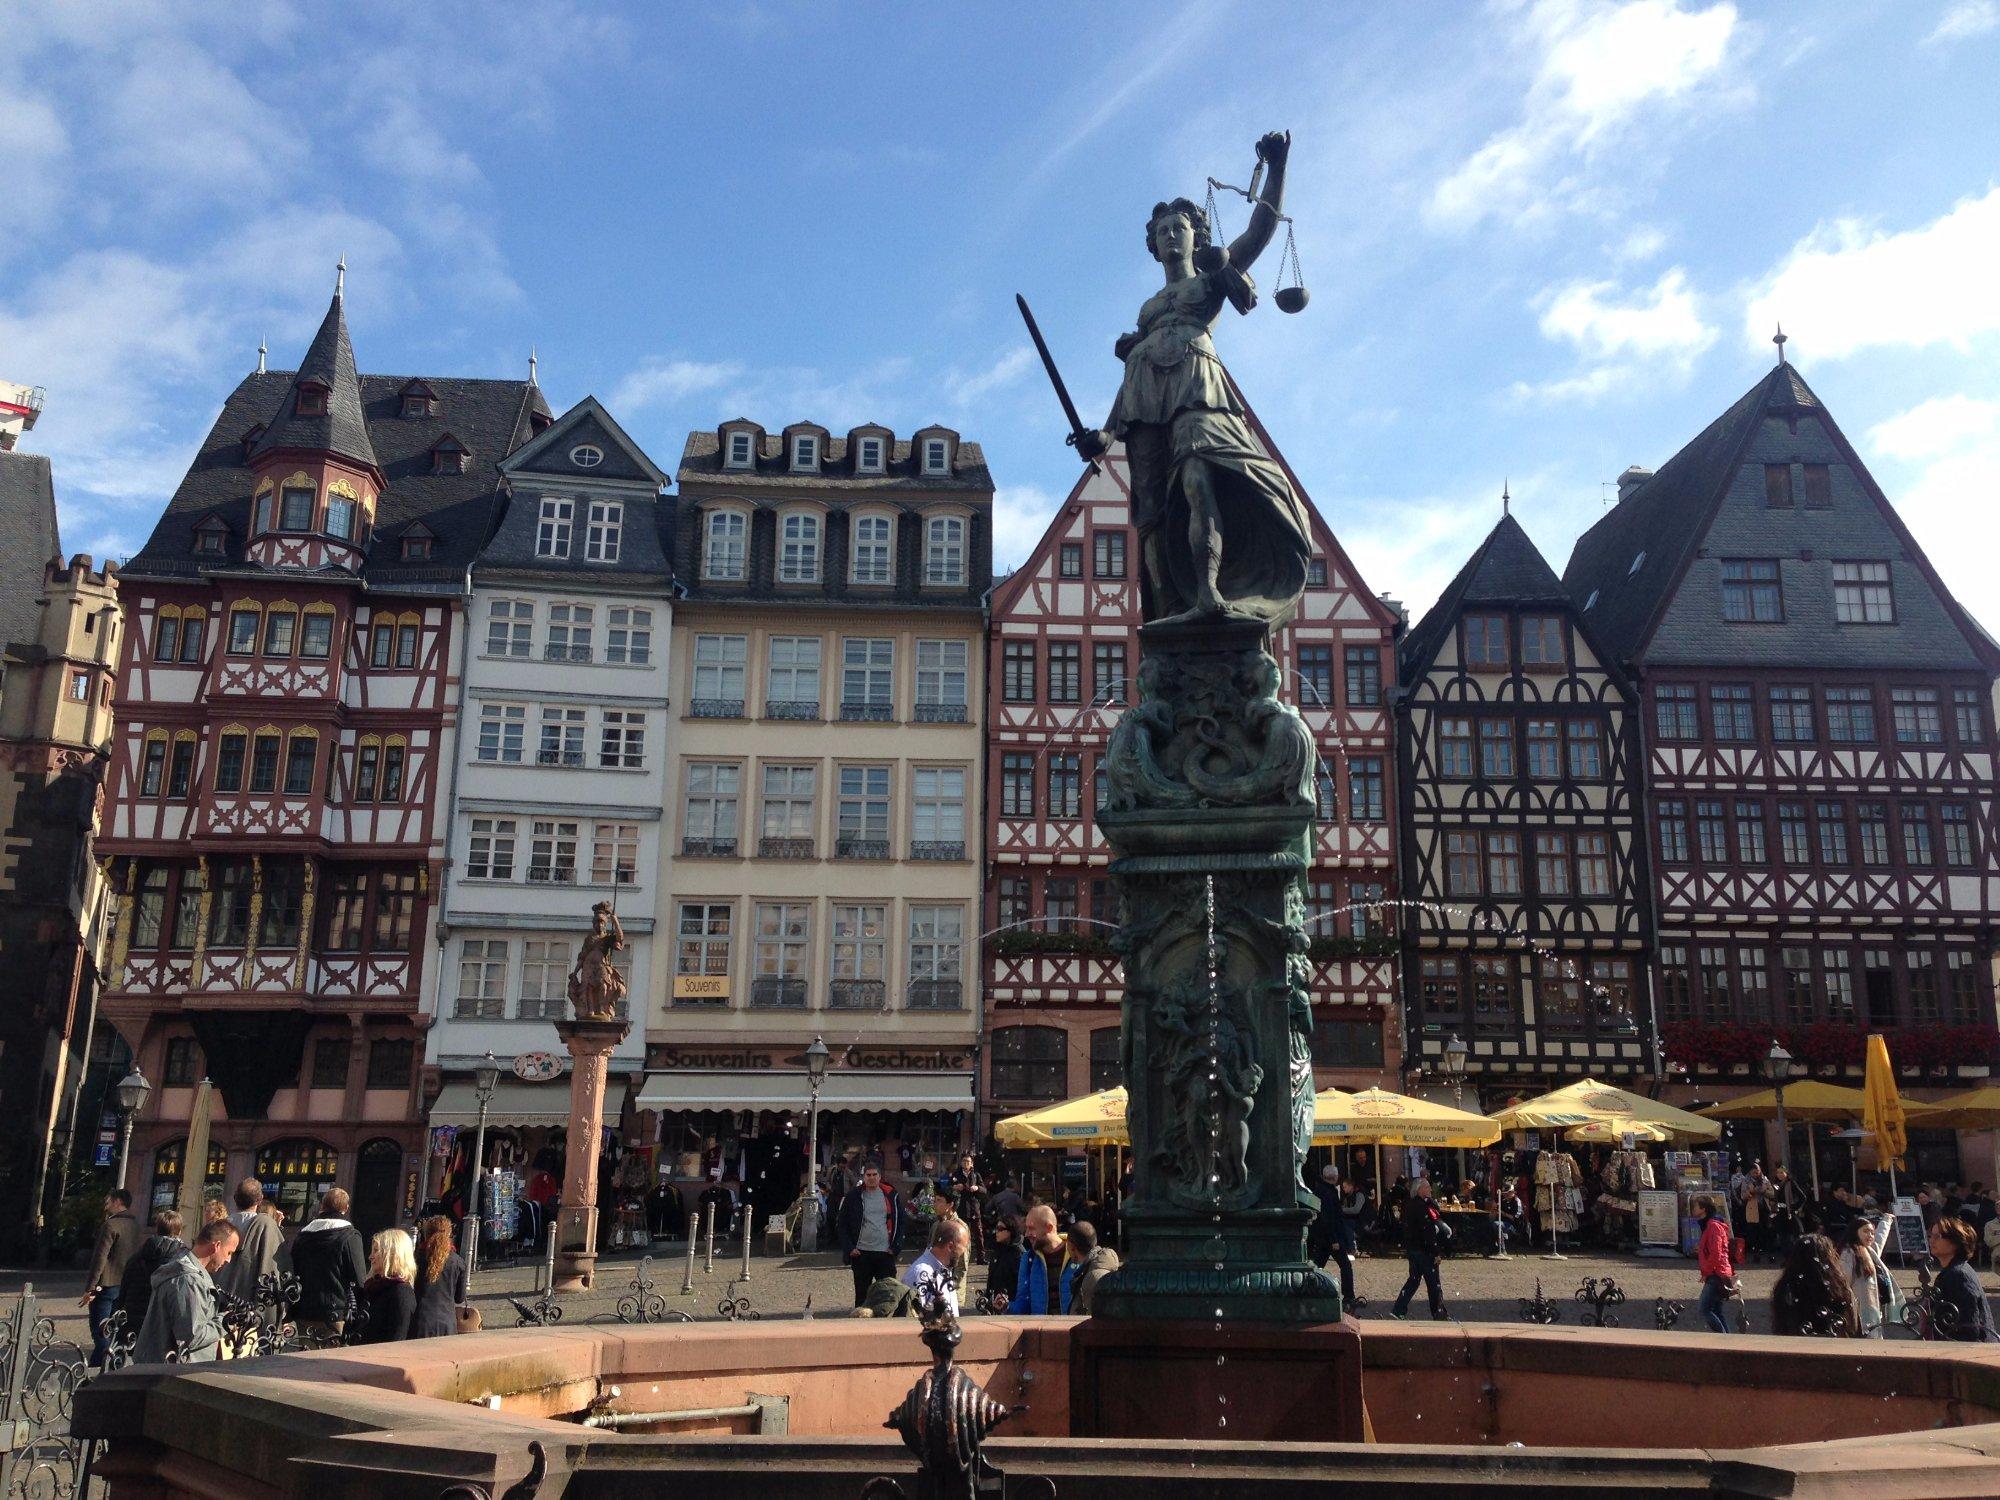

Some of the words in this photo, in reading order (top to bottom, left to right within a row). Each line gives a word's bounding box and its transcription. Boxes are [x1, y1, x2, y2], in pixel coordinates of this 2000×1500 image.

[684, 978, 721, 992] Souvenirs
[665, 1050, 772, 1067] Souvenirs
[847, 1051, 964, 1068] Geschenke
[157, 1161, 226, 1175] KAEE
[259, 1161, 337, 1174] CHANGE
